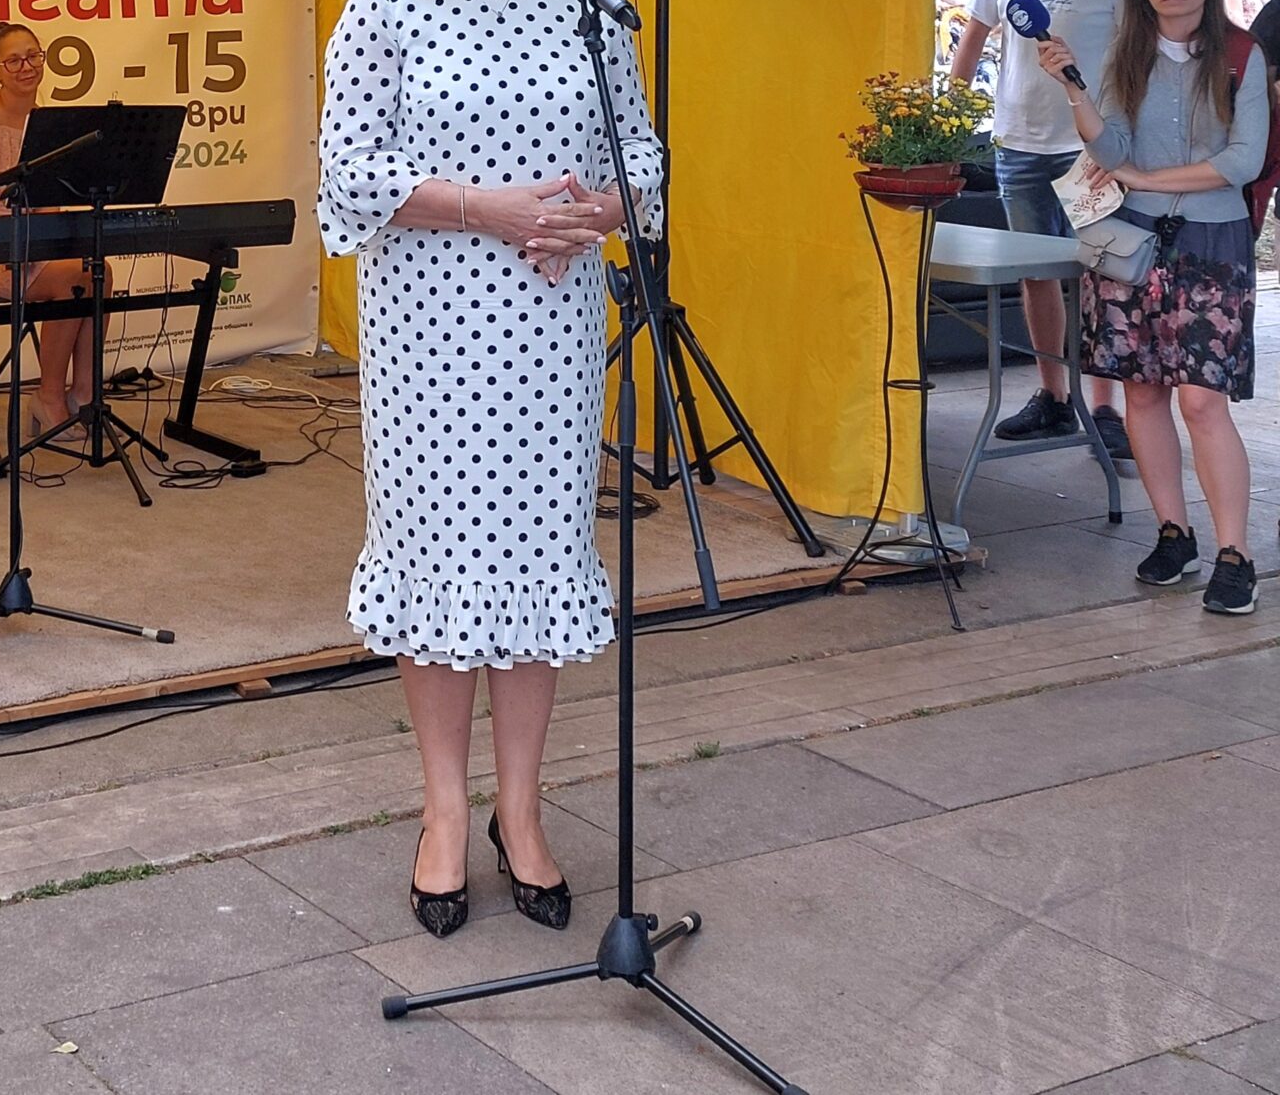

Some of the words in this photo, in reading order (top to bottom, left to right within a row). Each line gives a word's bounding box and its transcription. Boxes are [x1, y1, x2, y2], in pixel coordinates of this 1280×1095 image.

[46, 35, 96, 101] 9
[168, 30, 247, 94] 15
[186, 99, 246, 133] ври
[174, 139, 248, 169] 2024
